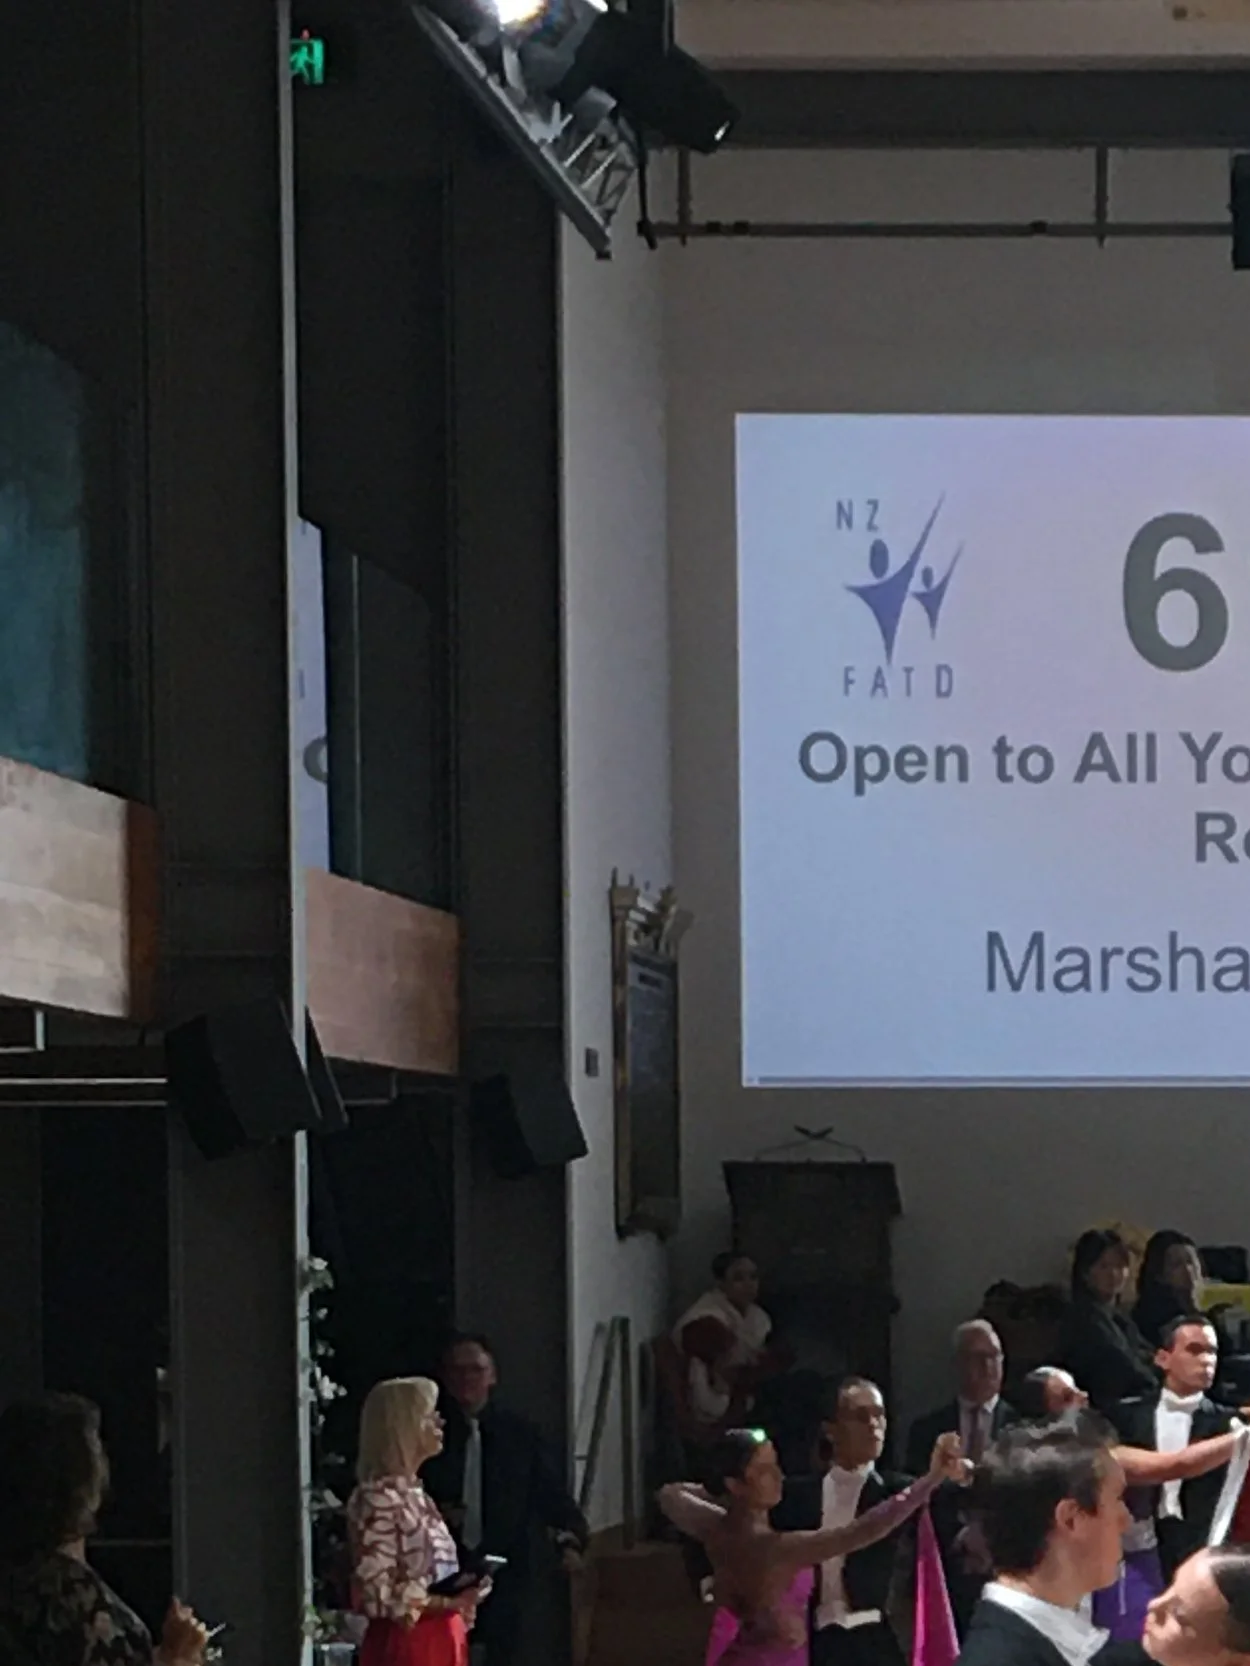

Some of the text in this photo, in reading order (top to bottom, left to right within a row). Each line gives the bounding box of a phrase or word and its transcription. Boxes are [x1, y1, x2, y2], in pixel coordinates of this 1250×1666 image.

[843, 664, 953, 699] FATD
[799, 731, 969, 797] Open
[991, 735, 1055, 785] to
[1073, 731, 1158, 784] All
